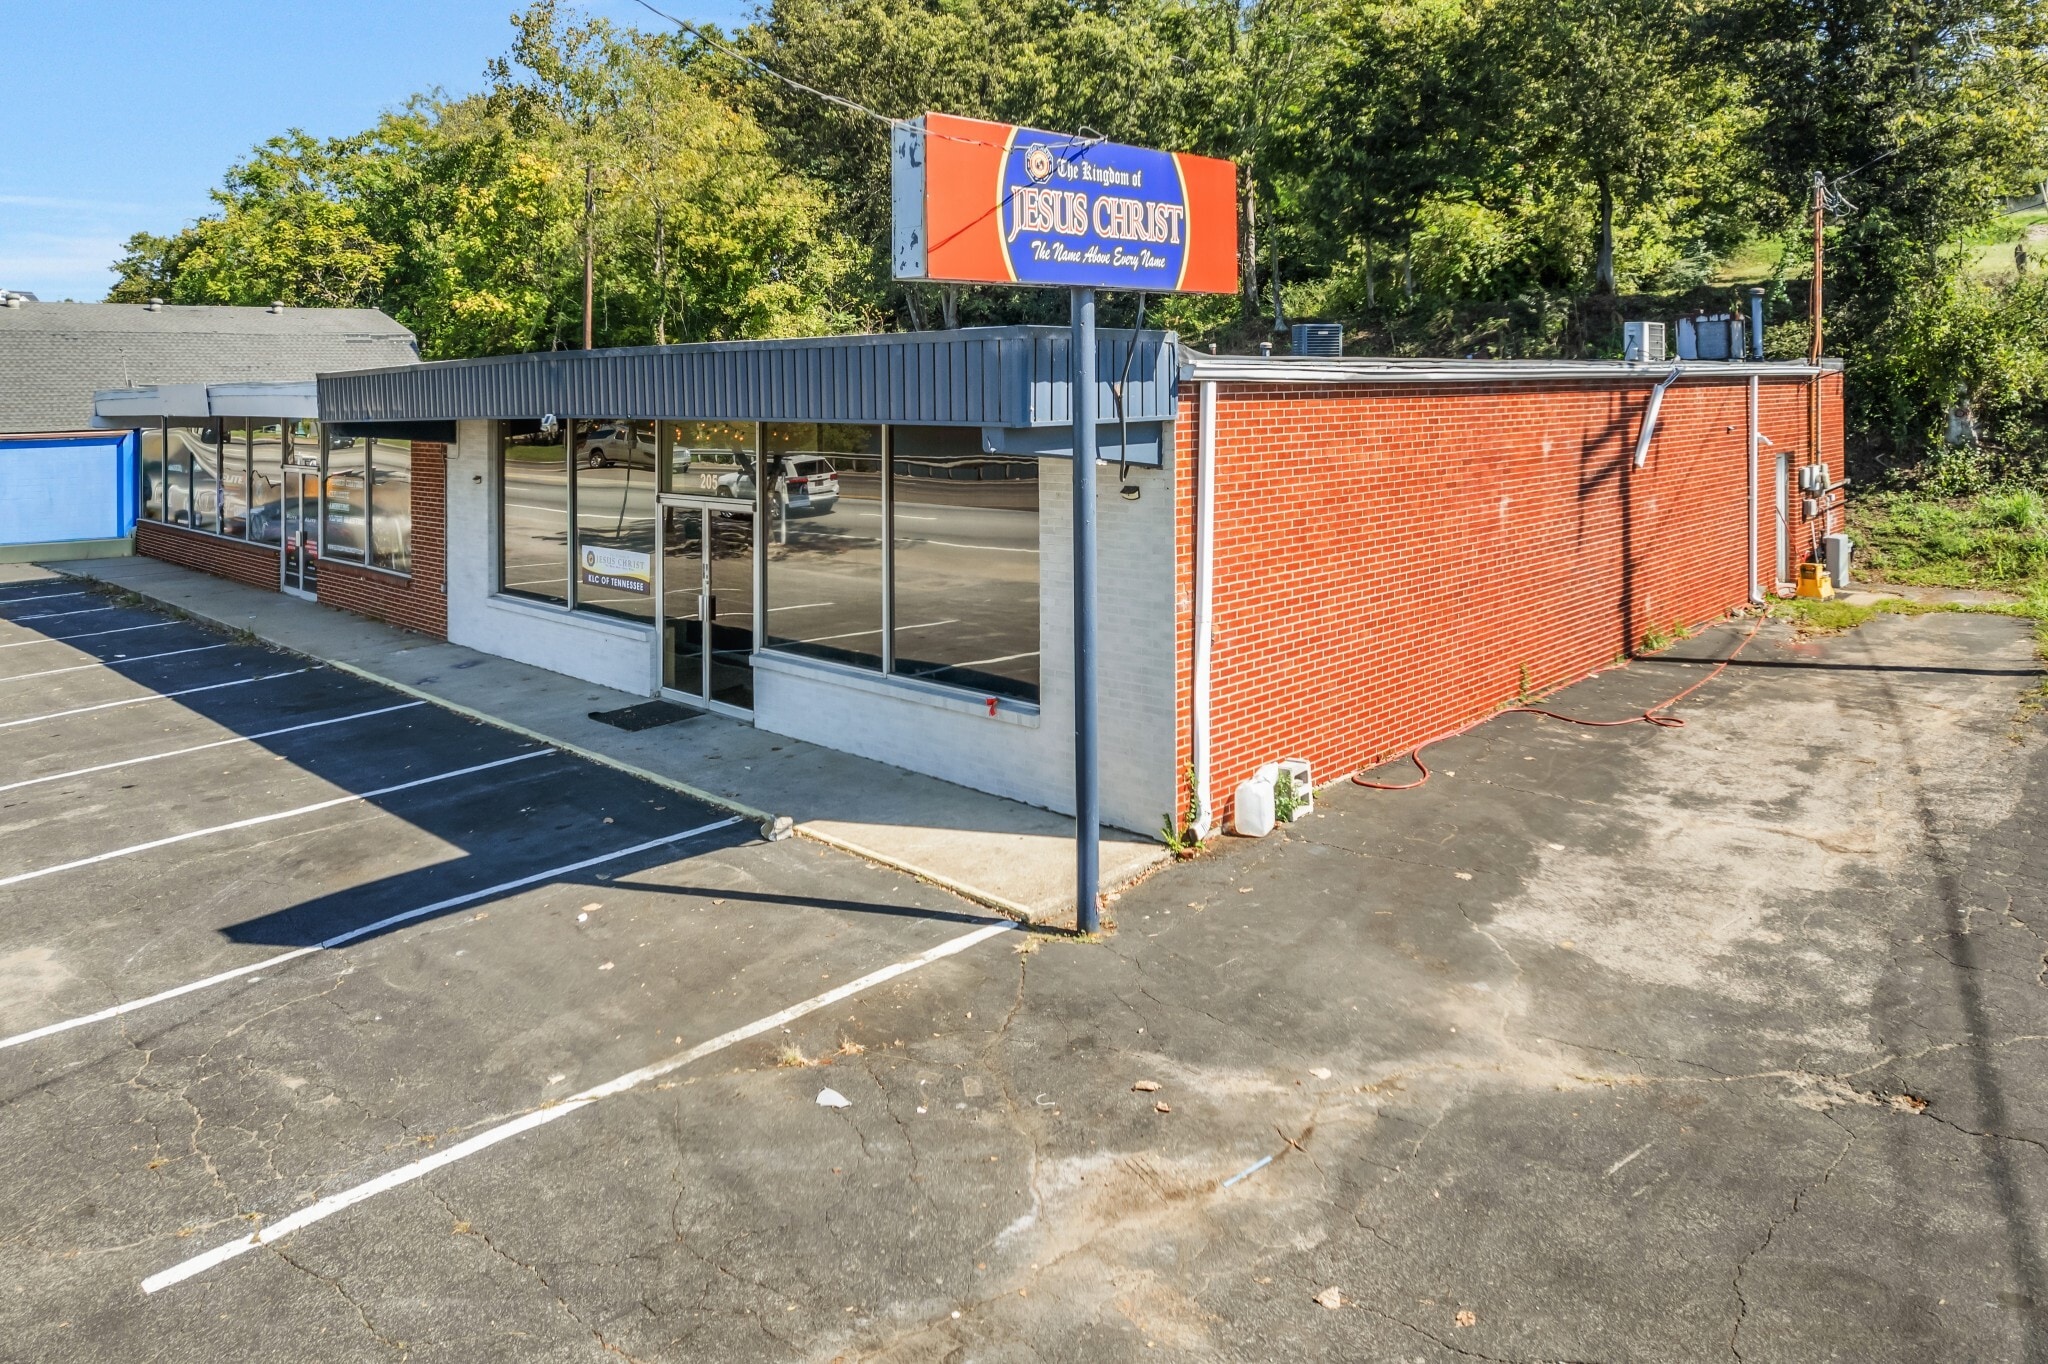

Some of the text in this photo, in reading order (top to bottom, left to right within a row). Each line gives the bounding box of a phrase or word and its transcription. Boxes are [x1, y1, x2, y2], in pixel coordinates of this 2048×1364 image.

[1057, 158, 1078, 181] The
[1081, 161, 1129, 186] Kingdom
[1132, 170, 1142, 187] of
[1008, 185, 1184, 245] JESUS CHRIST
[1031, 240, 1166, 271] The Name Above Every Name
[700, 473, 718, 490] 205
[596, 554, 616, 566] JESUS
[617, 558, 645, 570] CHRIST
[588, 574, 644, 592] KLC OF TENNESSEE
